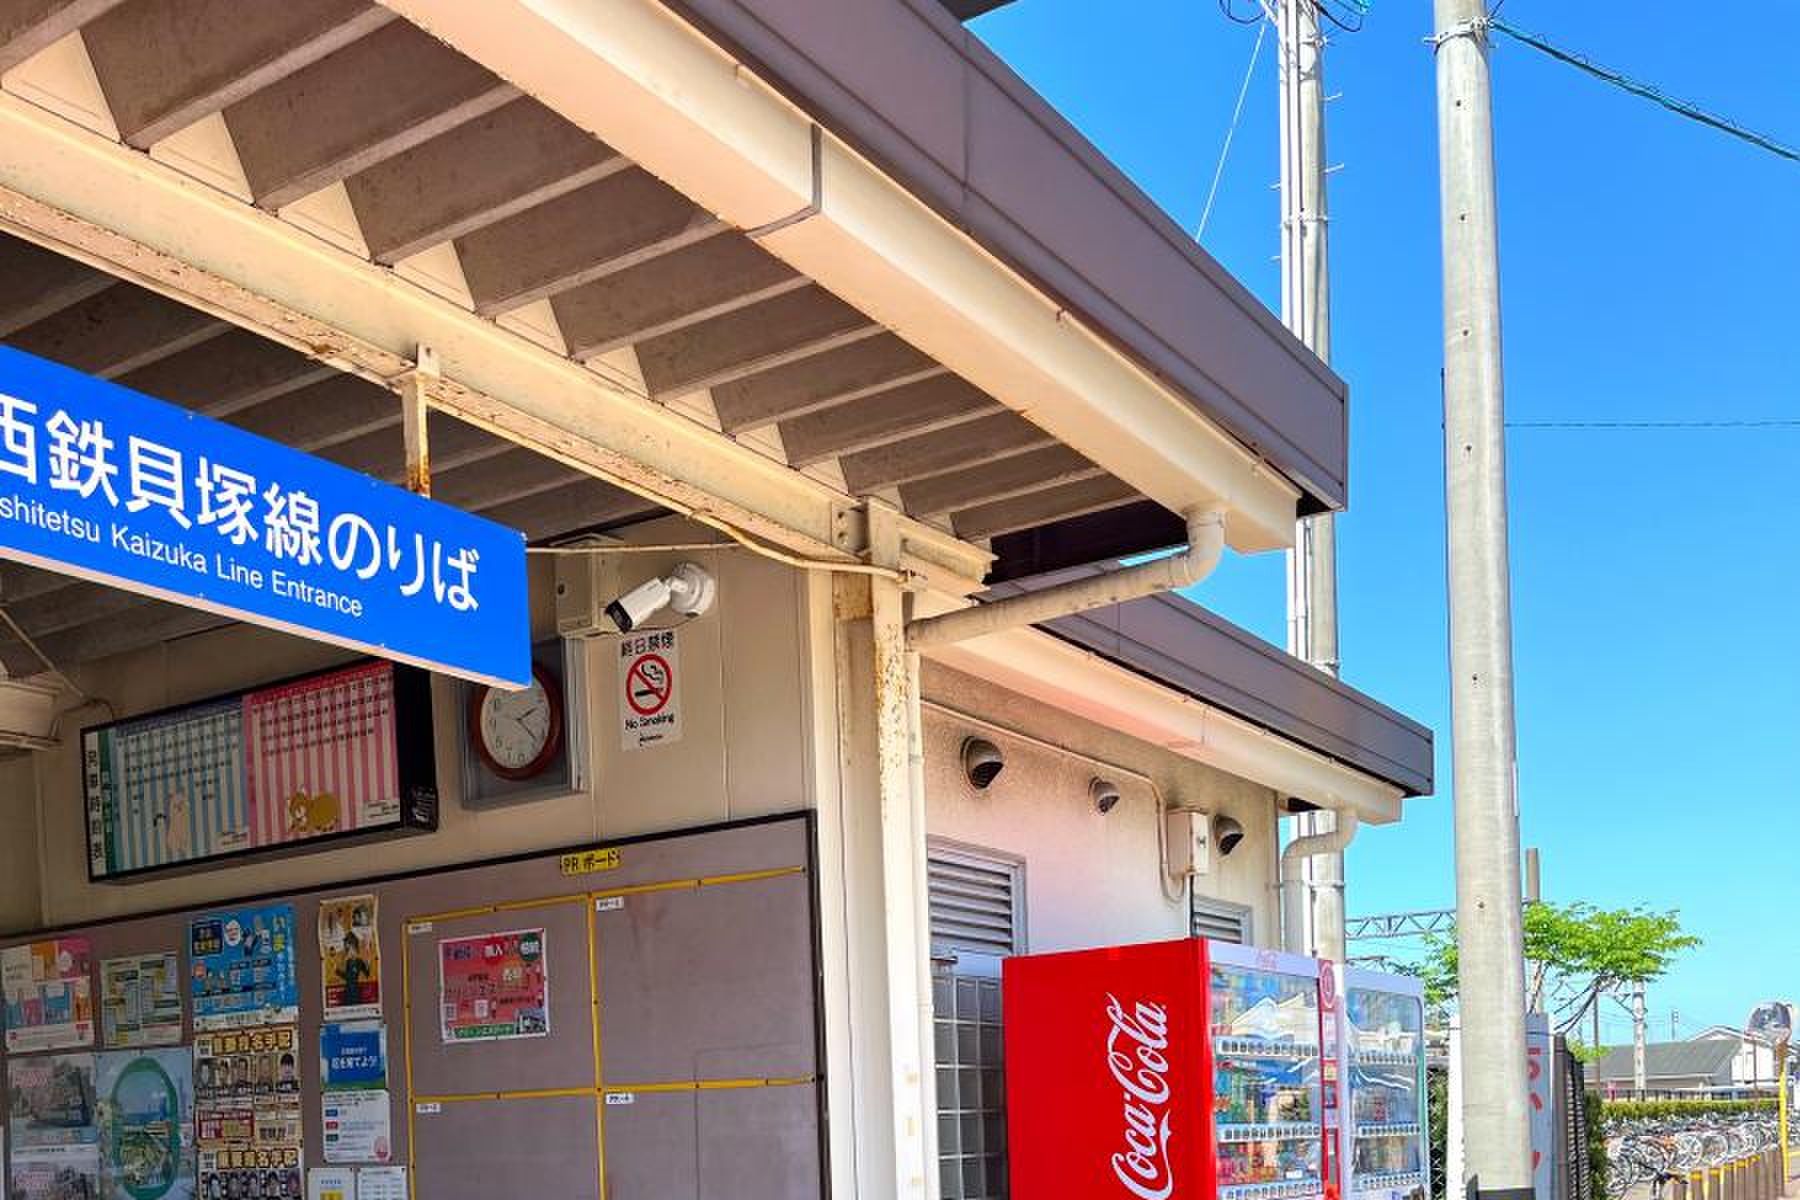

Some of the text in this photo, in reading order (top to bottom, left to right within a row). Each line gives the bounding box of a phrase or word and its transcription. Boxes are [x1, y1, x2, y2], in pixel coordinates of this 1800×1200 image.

[111, 523, 208, 576] Kaizuka
[216, 553, 264, 589] Line
[271, 570, 364, 618] Entrance
[625, 713, 674, 731] No Smoking
